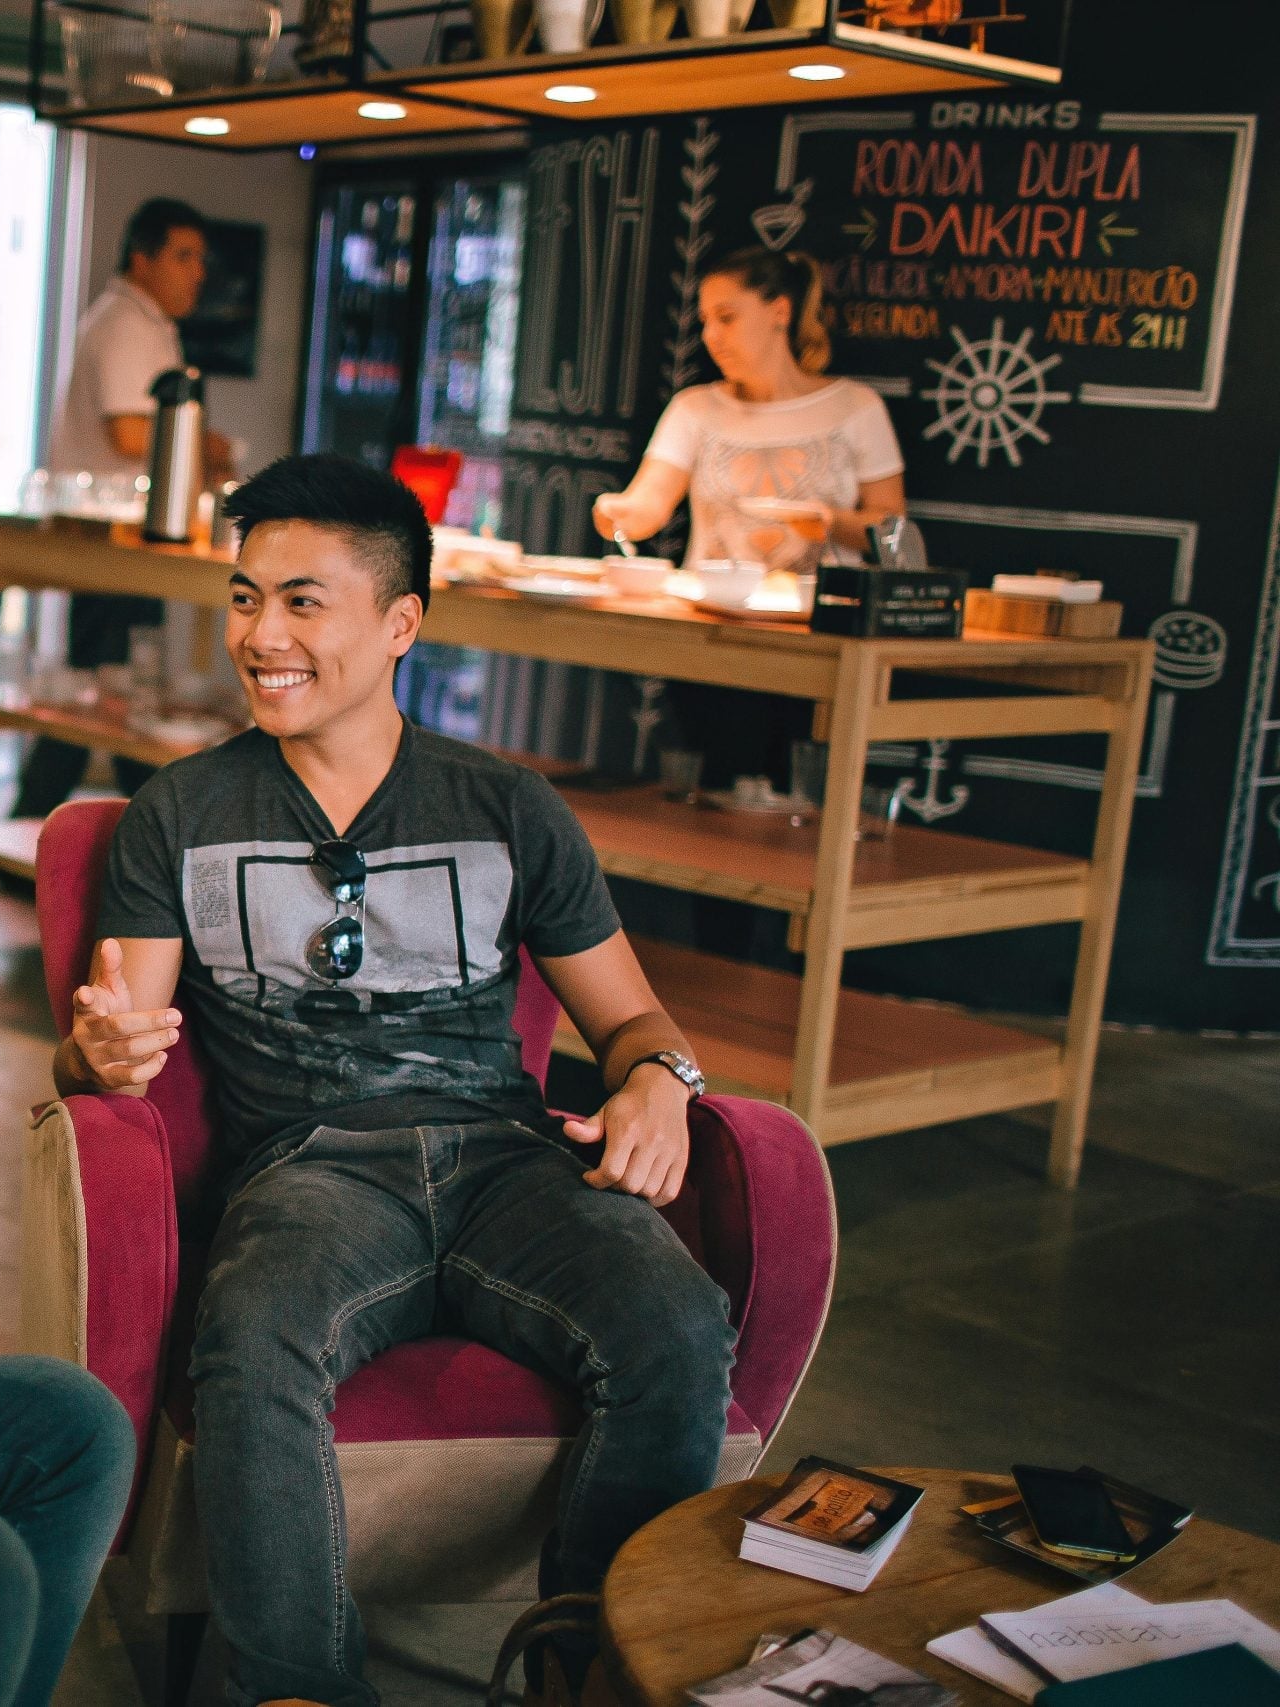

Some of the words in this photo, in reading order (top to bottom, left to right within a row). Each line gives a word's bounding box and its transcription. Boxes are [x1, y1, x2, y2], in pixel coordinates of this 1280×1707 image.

[931, 101, 1081, 129] DRINKS
[852, 139, 983, 197] RODADA
[1017, 140, 1140, 200] DUPLA
[889, 202, 1087, 259] DAIKIRI
[943, 264, 1034, 300] AMORA
[1017, 1621, 1181, 1649] habitat
